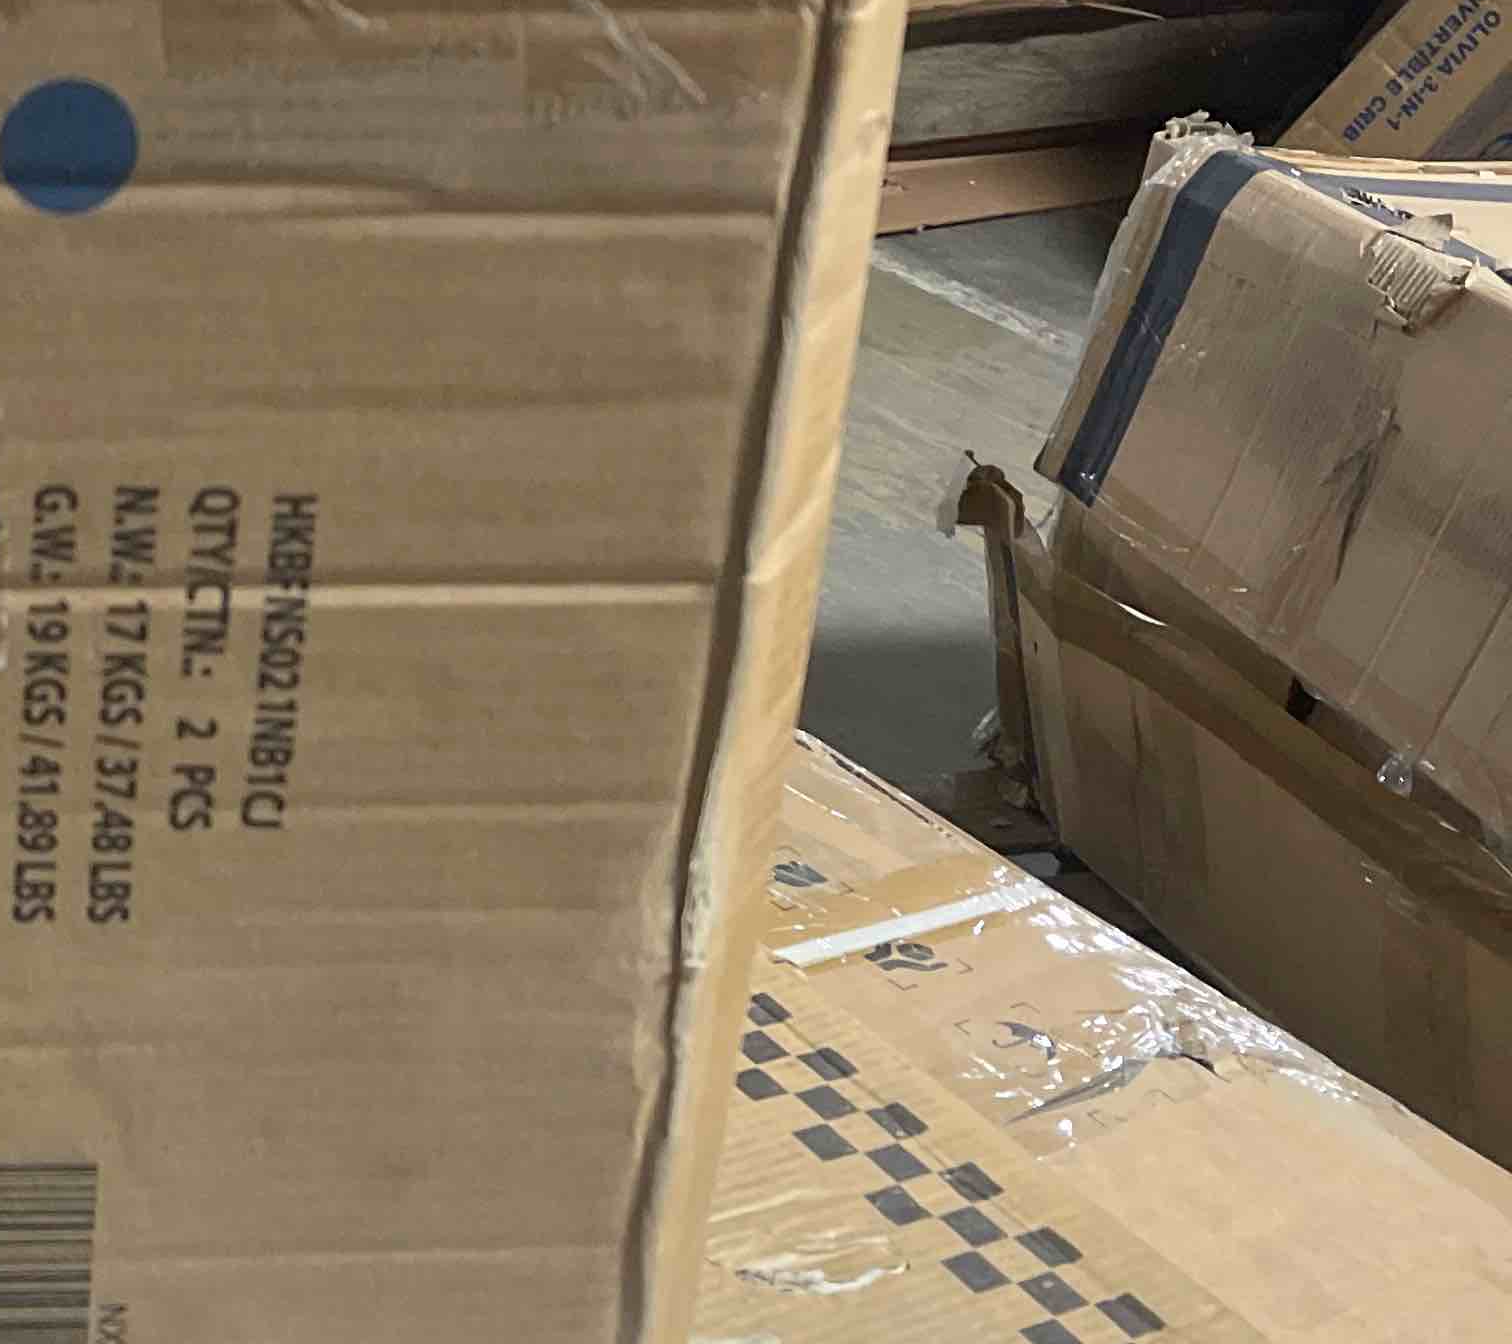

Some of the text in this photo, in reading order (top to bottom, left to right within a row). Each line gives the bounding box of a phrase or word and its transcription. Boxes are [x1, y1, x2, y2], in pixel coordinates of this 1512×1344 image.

[1343, 95, 1387, 142] CRIB
[1386, 10, 1501, 131] OLIVIA 3-IN-1
[12, 484, 80, 926] G.W.: 19 KGS / 41.89 LBS
[86, 485, 160, 926] N.W.: 17 KGS / 37.48 LBS
[241, 493, 318, 830] HKBFNS021NB1CJ
[175, 717, 217, 741] 2
[170, 766, 217, 833] PCS
